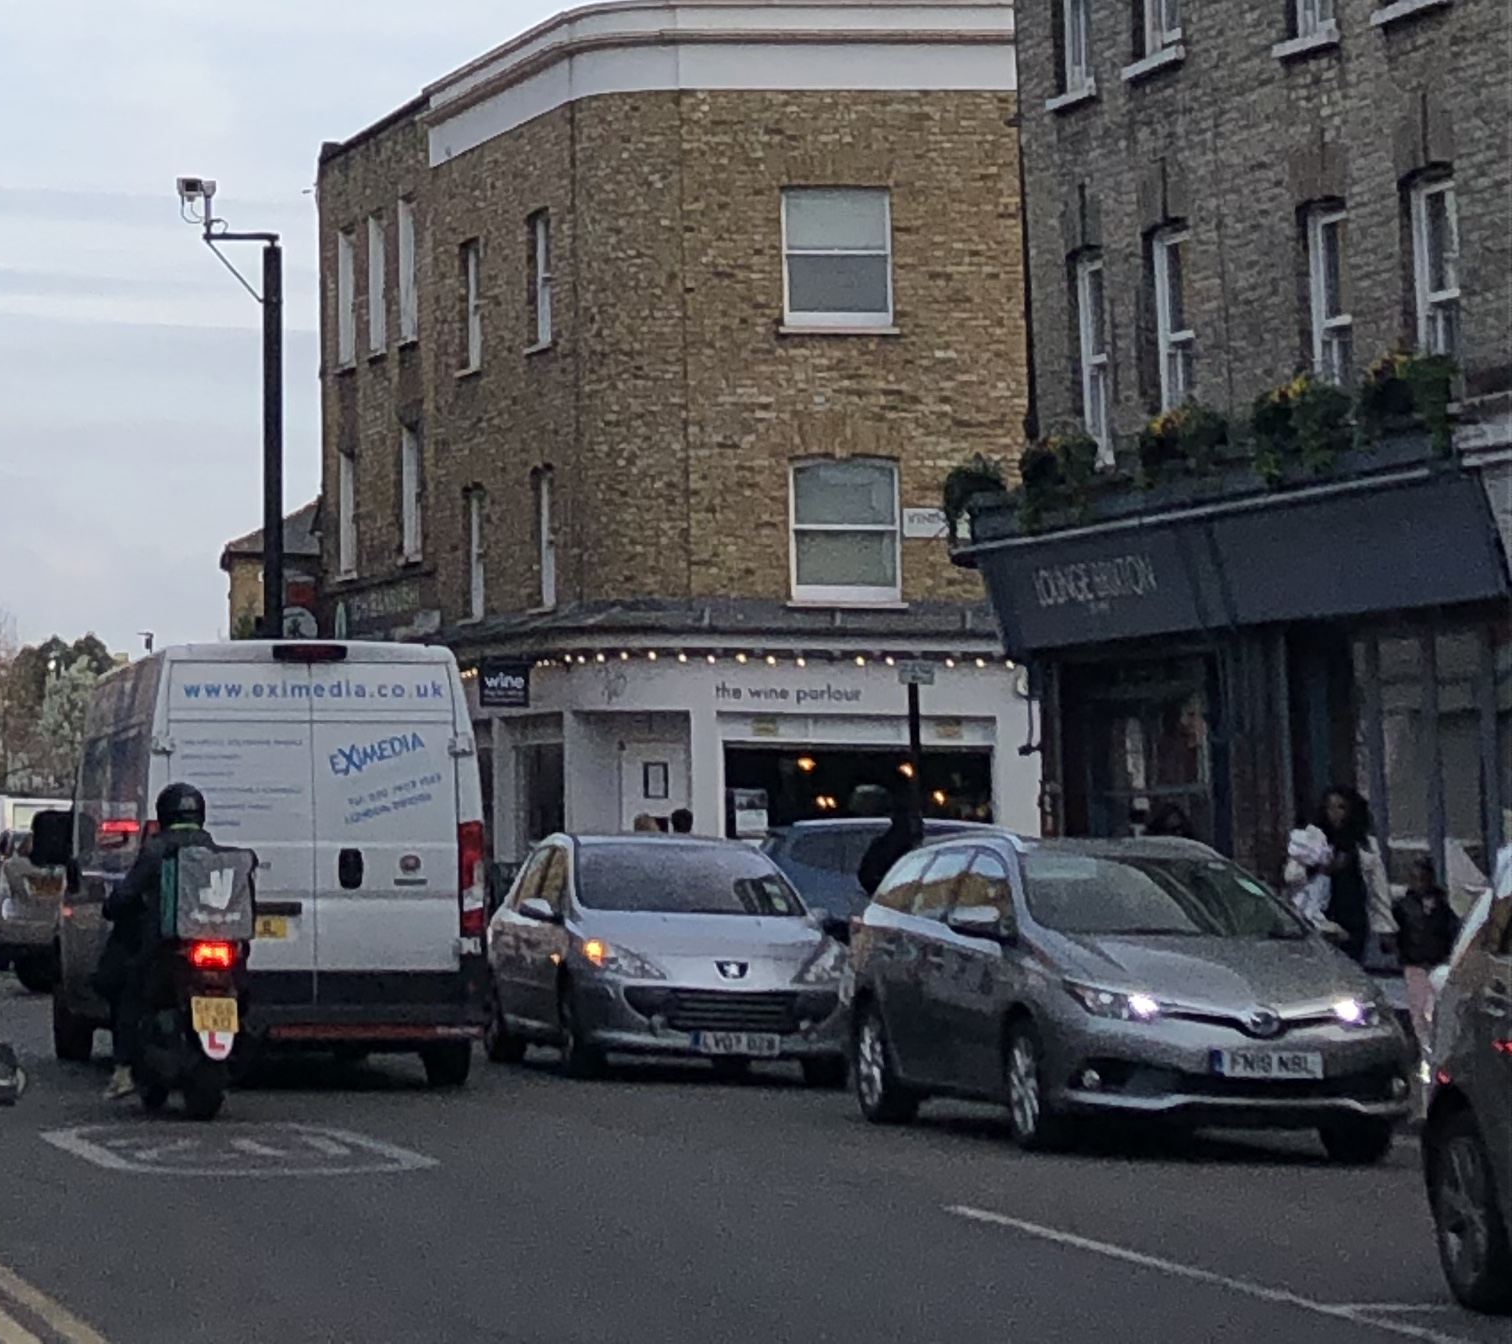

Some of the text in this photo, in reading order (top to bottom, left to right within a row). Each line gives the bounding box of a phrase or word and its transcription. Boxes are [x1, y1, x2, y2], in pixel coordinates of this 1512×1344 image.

[183, 680, 443, 699] www.eximedia.co.uk
[484, 672, 524, 689] wine
[716, 682, 861, 704] the wine parlour
[329, 732, 425, 776] EXIMEDIA
